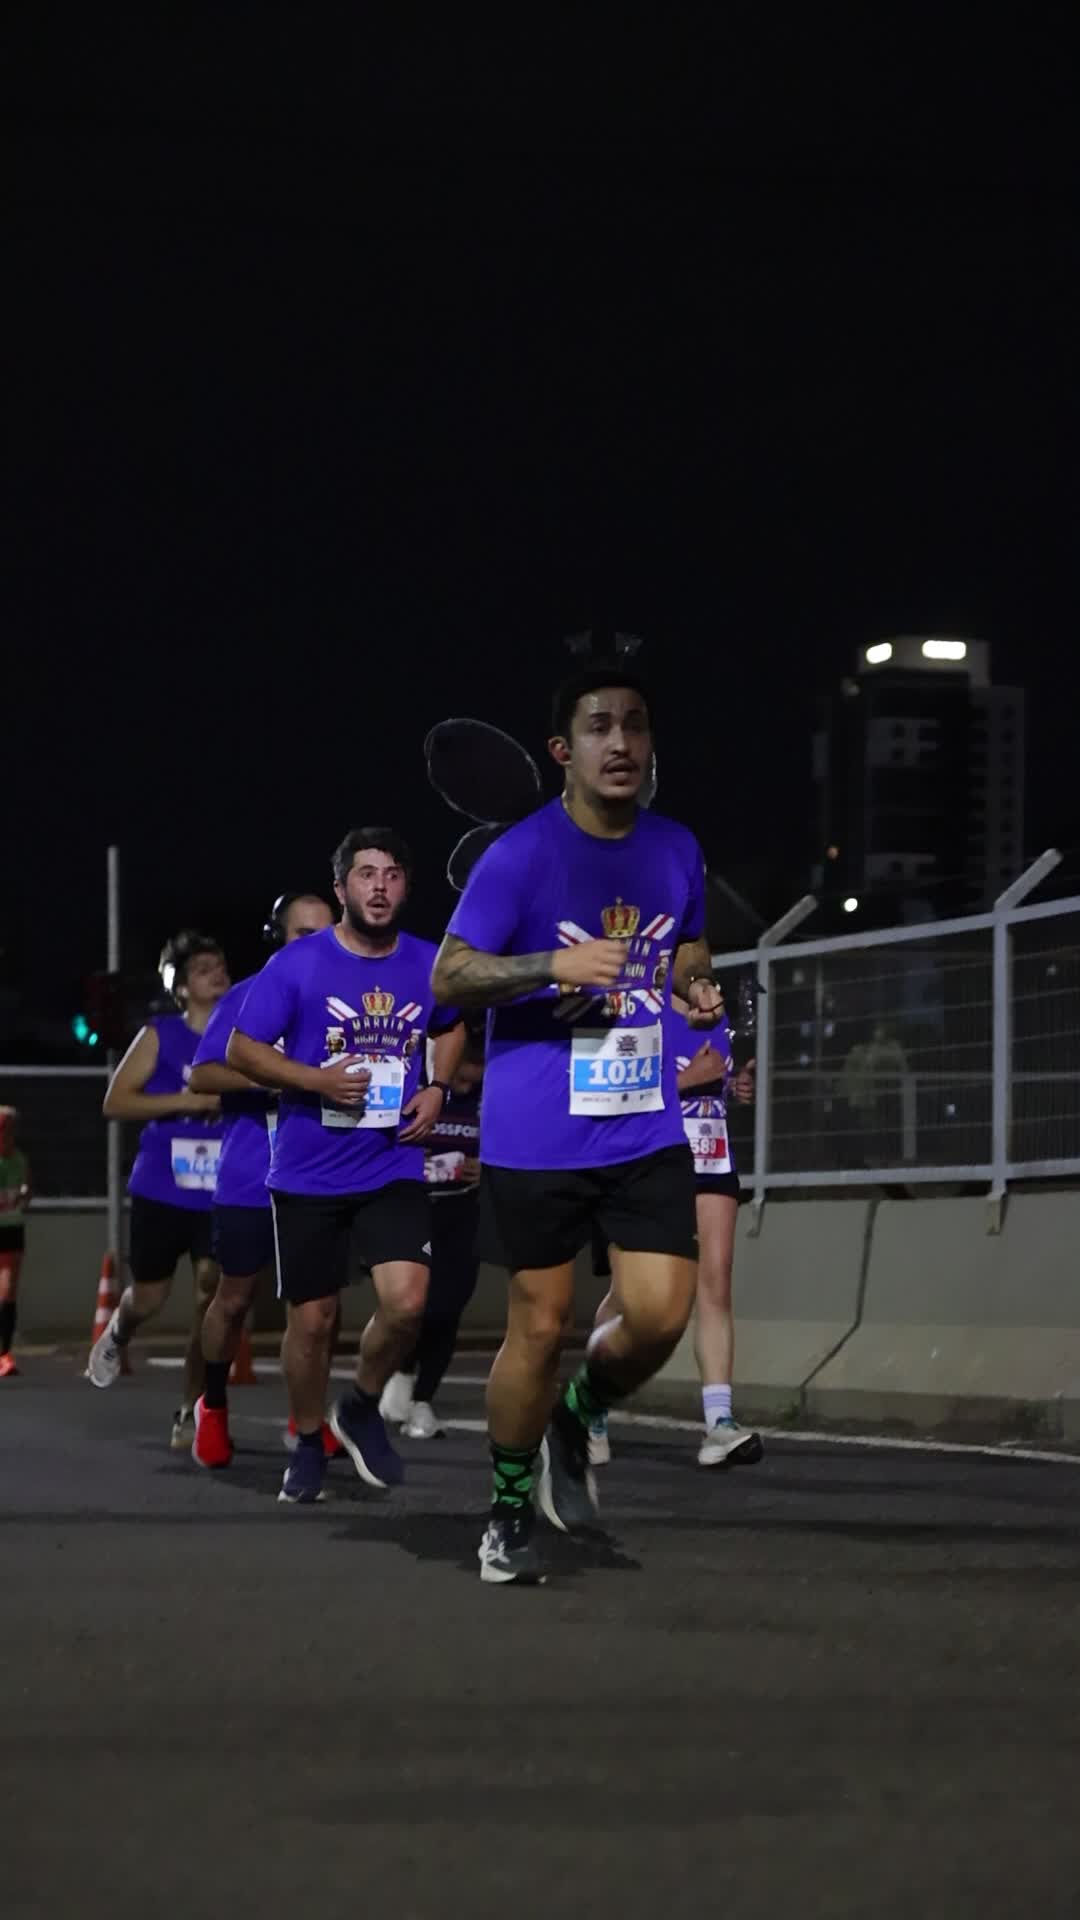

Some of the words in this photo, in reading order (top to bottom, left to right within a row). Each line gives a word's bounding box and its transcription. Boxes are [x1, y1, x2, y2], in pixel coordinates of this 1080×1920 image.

[352, 1017, 405, 1032] MARVIN
[354, 1033, 379, 1045] NIGHT
[381, 1034, 400, 1047] RUN
[588, 1057, 652, 1085] 1014
[366, 1085, 385, 1105] 1
